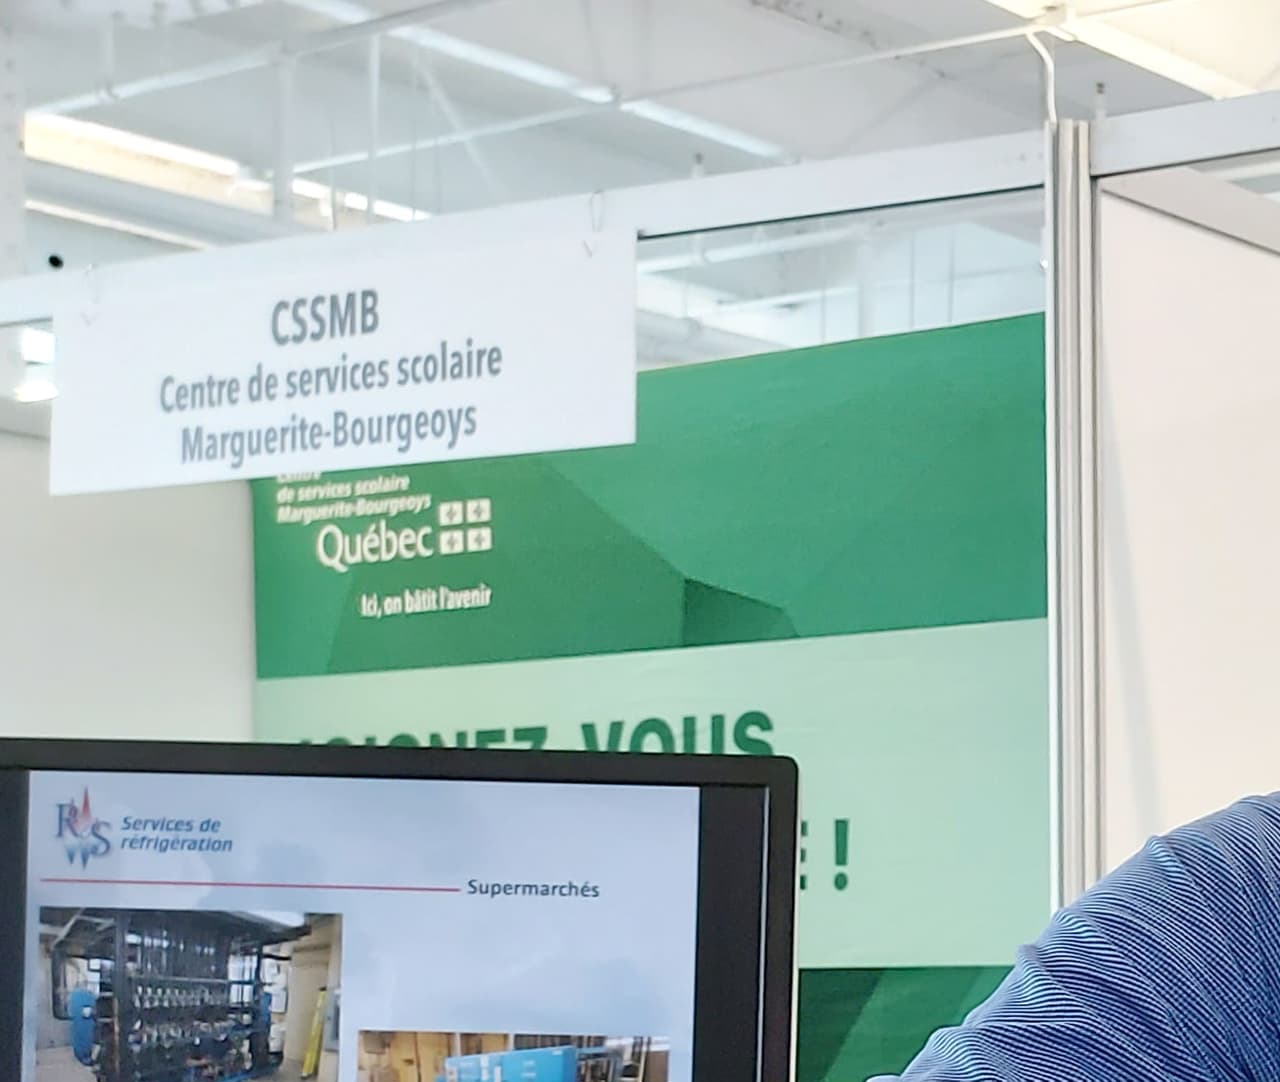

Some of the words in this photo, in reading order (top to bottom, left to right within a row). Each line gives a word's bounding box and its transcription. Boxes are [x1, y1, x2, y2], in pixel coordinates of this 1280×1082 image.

[271, 289, 379, 346] CSSMB
[159, 376, 240, 413] Centre
[248, 365, 278, 401] de
[286, 354, 389, 397] services
[396, 339, 502, 384] scolaire
[180, 405, 477, 469] Marguerite-Bourgeoys
[316, 519, 434, 573] Québec
[360, 593, 382, 619] Ici,
[383, 594, 401, 614] on
[56, 802, 112, 857] RS
[121, 816, 193, 832] Services
[199, 817, 221, 833] de
[121, 835, 233, 854] réfrigération
[467, 878, 600, 899] Supermarchés
